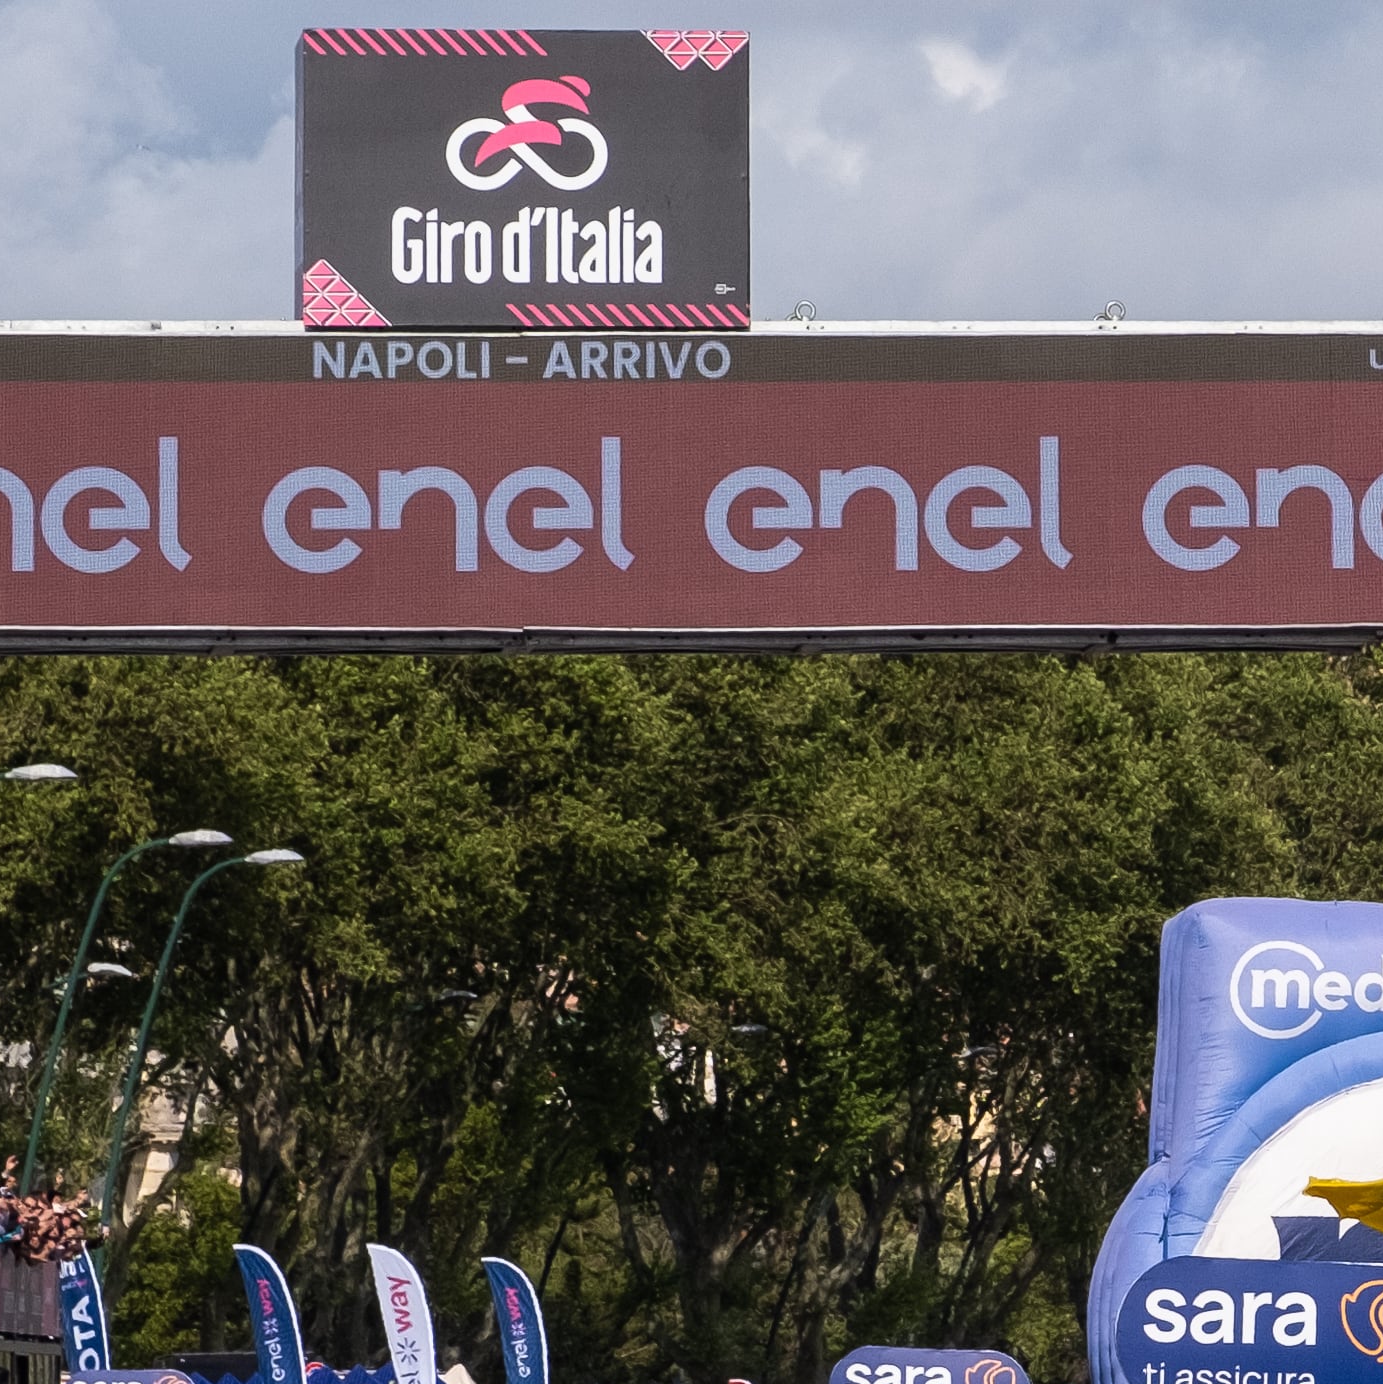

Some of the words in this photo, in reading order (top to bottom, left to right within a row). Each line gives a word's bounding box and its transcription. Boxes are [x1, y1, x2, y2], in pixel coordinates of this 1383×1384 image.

[391, 206, 492, 284] Giro
[502, 206, 664, 284] d'Italia
[312, 340, 491, 380] NAPOLI
[542, 340, 732, 380] ARRIVO
[262, 436, 636, 574] enel
[704, 436, 1074, 574] enel
[257, 1278, 276, 1317] way
[386, 1274, 413, 1335] way
[1143, 1288, 1317, 1347] sara
